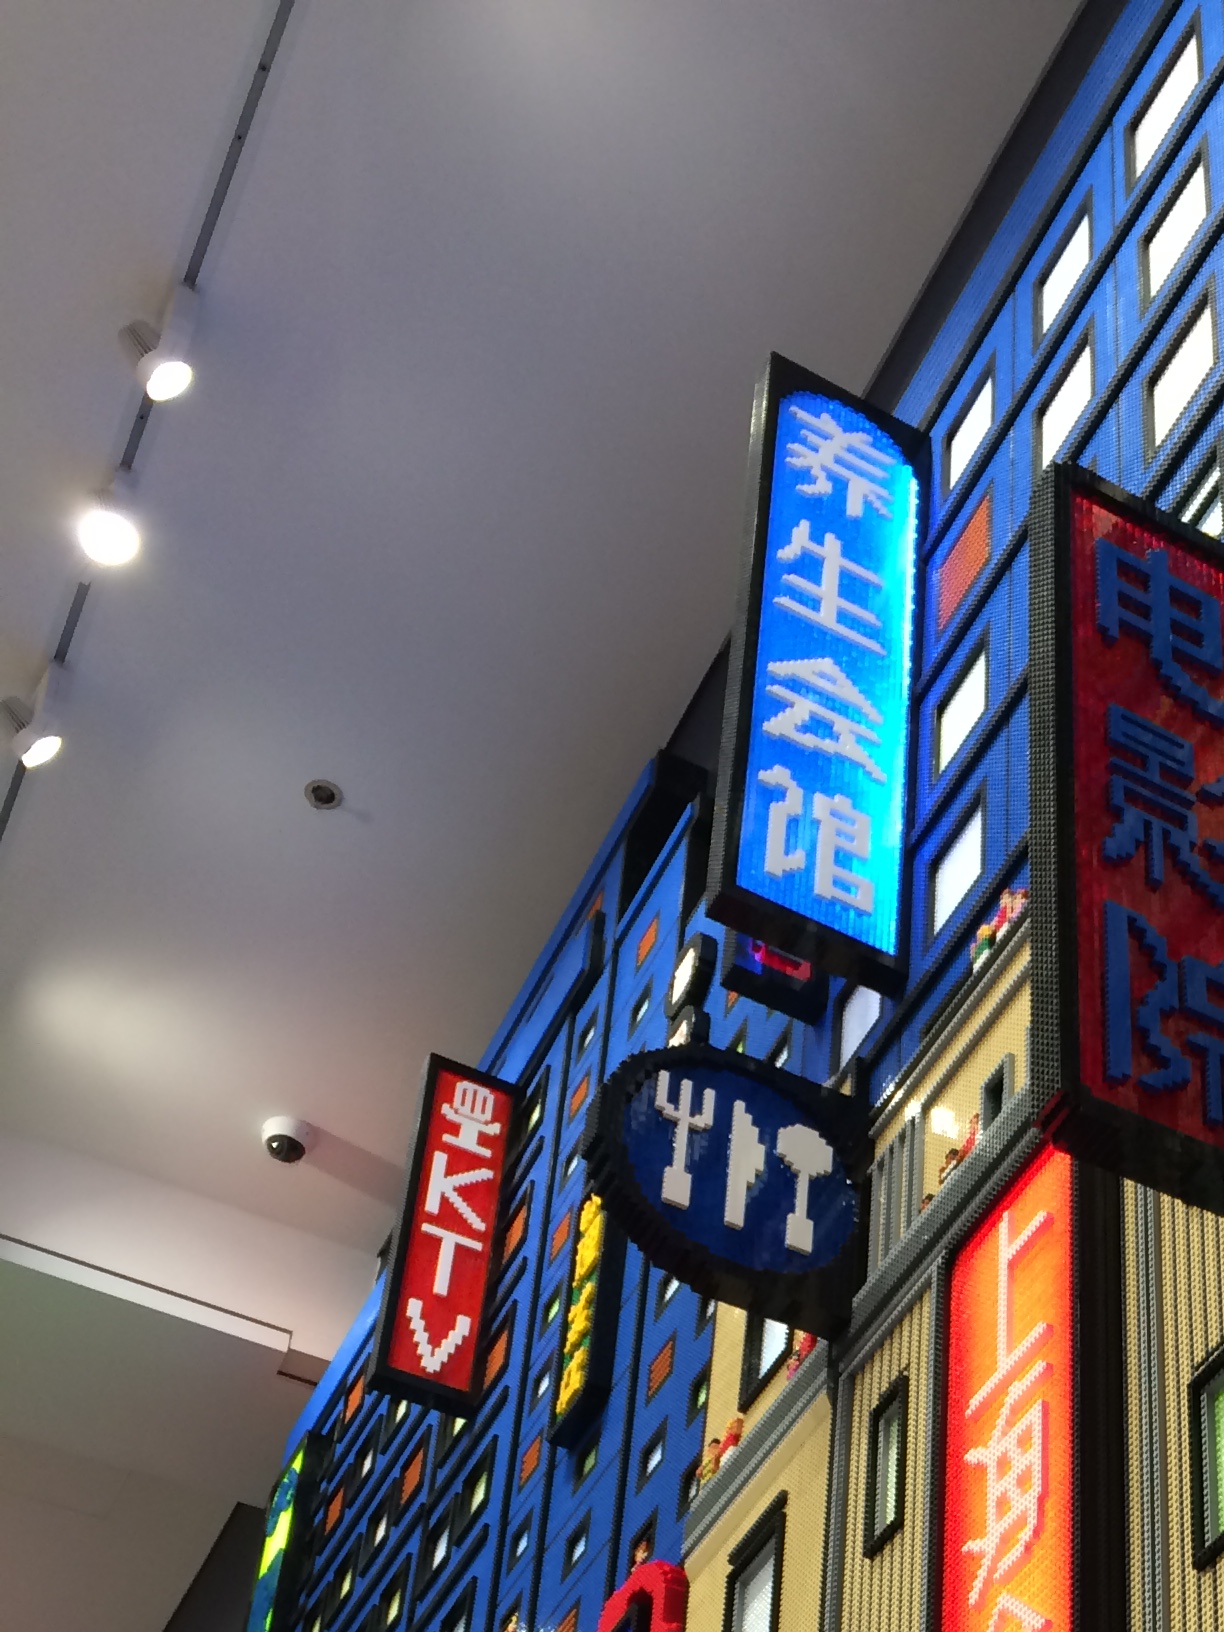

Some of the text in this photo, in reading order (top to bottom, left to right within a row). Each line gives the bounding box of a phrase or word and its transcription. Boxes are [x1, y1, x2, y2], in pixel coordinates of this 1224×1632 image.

[758, 403, 894, 915] 养生会馆
[405, 1150, 494, 1374] KTV
